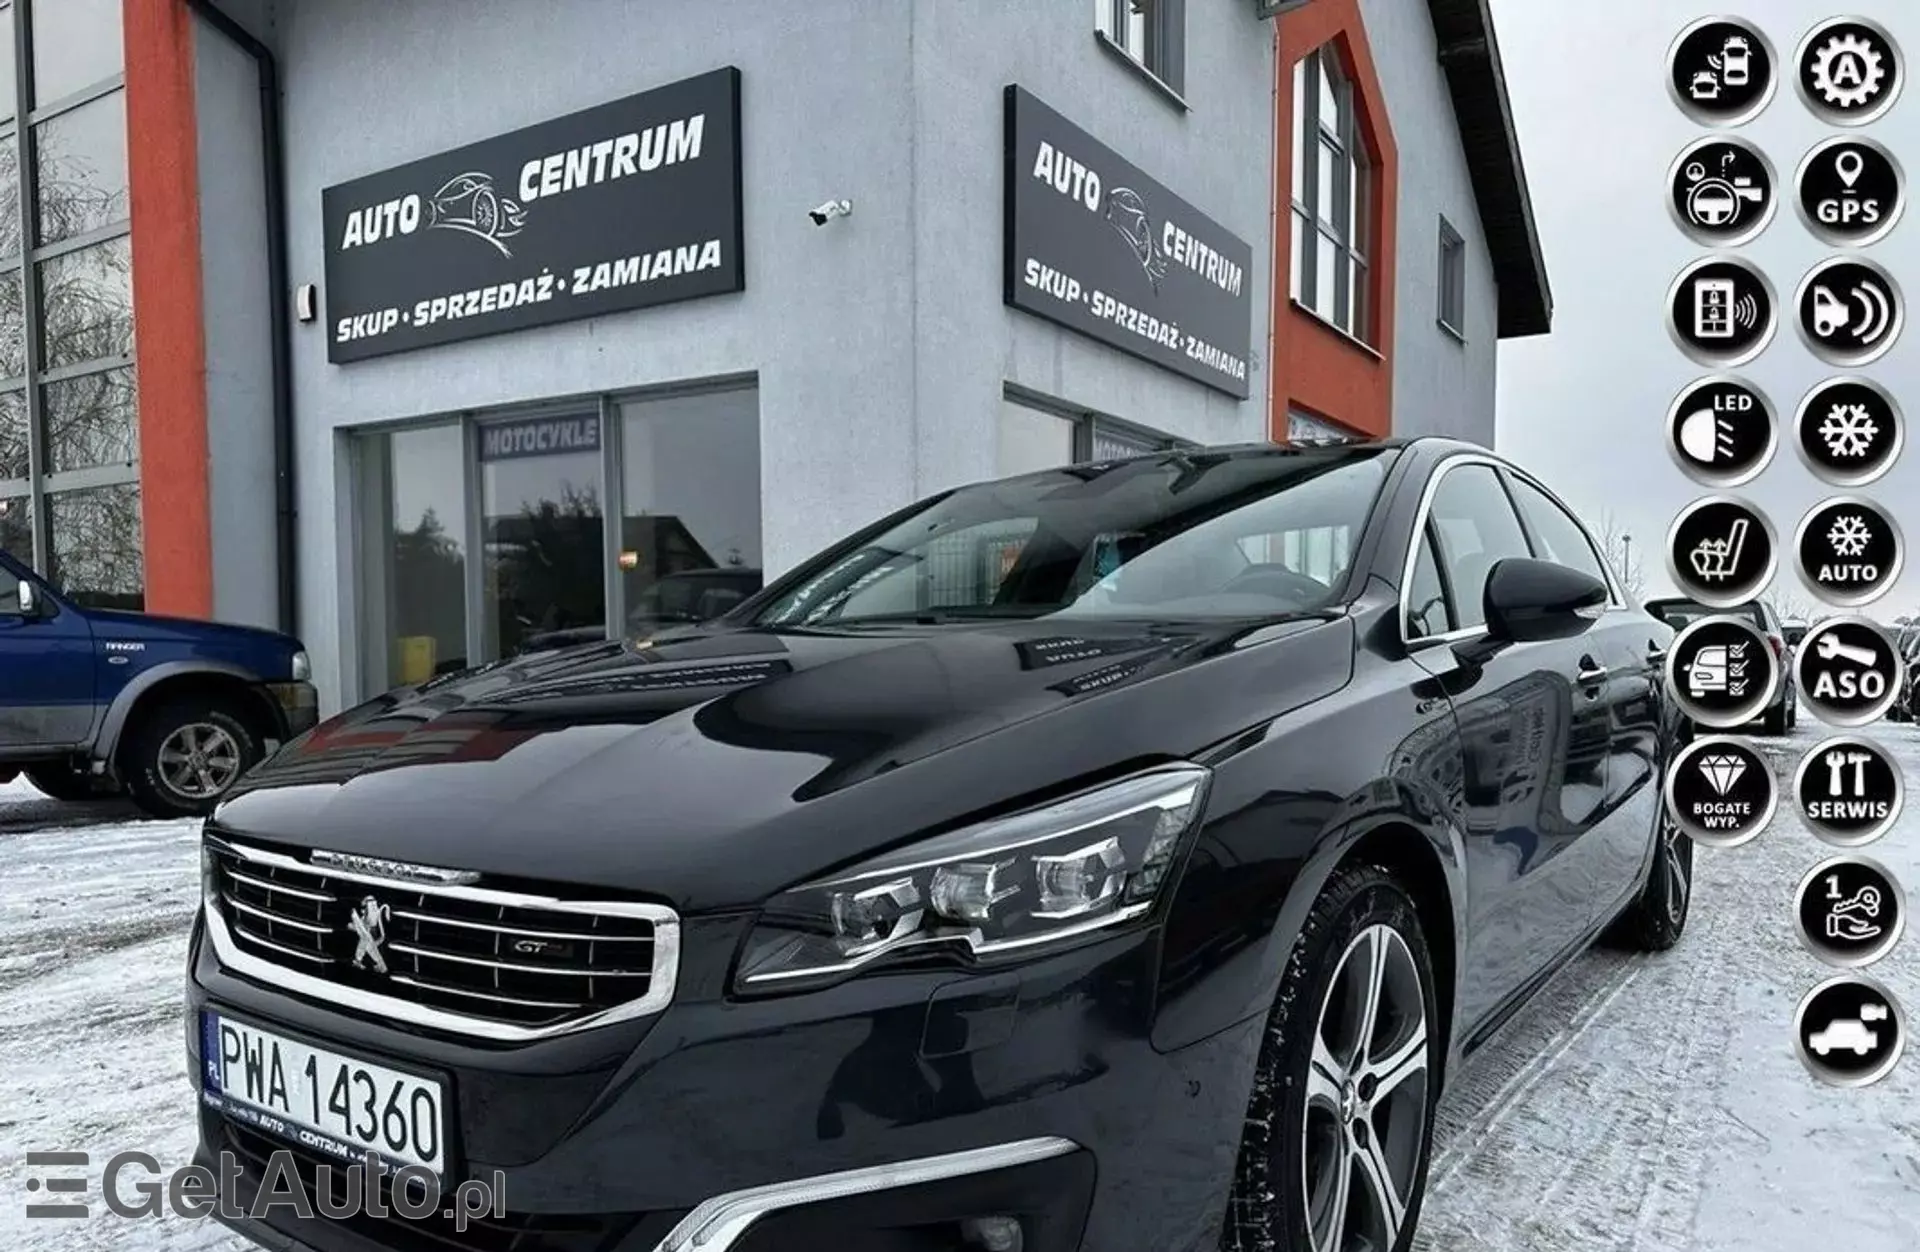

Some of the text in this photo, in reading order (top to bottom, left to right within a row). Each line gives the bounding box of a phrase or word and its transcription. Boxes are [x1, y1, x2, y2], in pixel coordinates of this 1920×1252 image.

[342, 114, 705, 249] AUTO CENTRUM
[1033, 141, 1242, 297] AUTO CENTRUM
[336, 239, 721, 342] SKUP SPRZEDAŻ ZAMIANA
[1024, 258, 1245, 380] SKUP SPRZEDAŻ ZAMIANA
[485, 419, 597, 455] MOTOCYKLE
[221, 1023, 437, 1162] PWA 14360
[260, 1114, 285, 1133] AUTO
